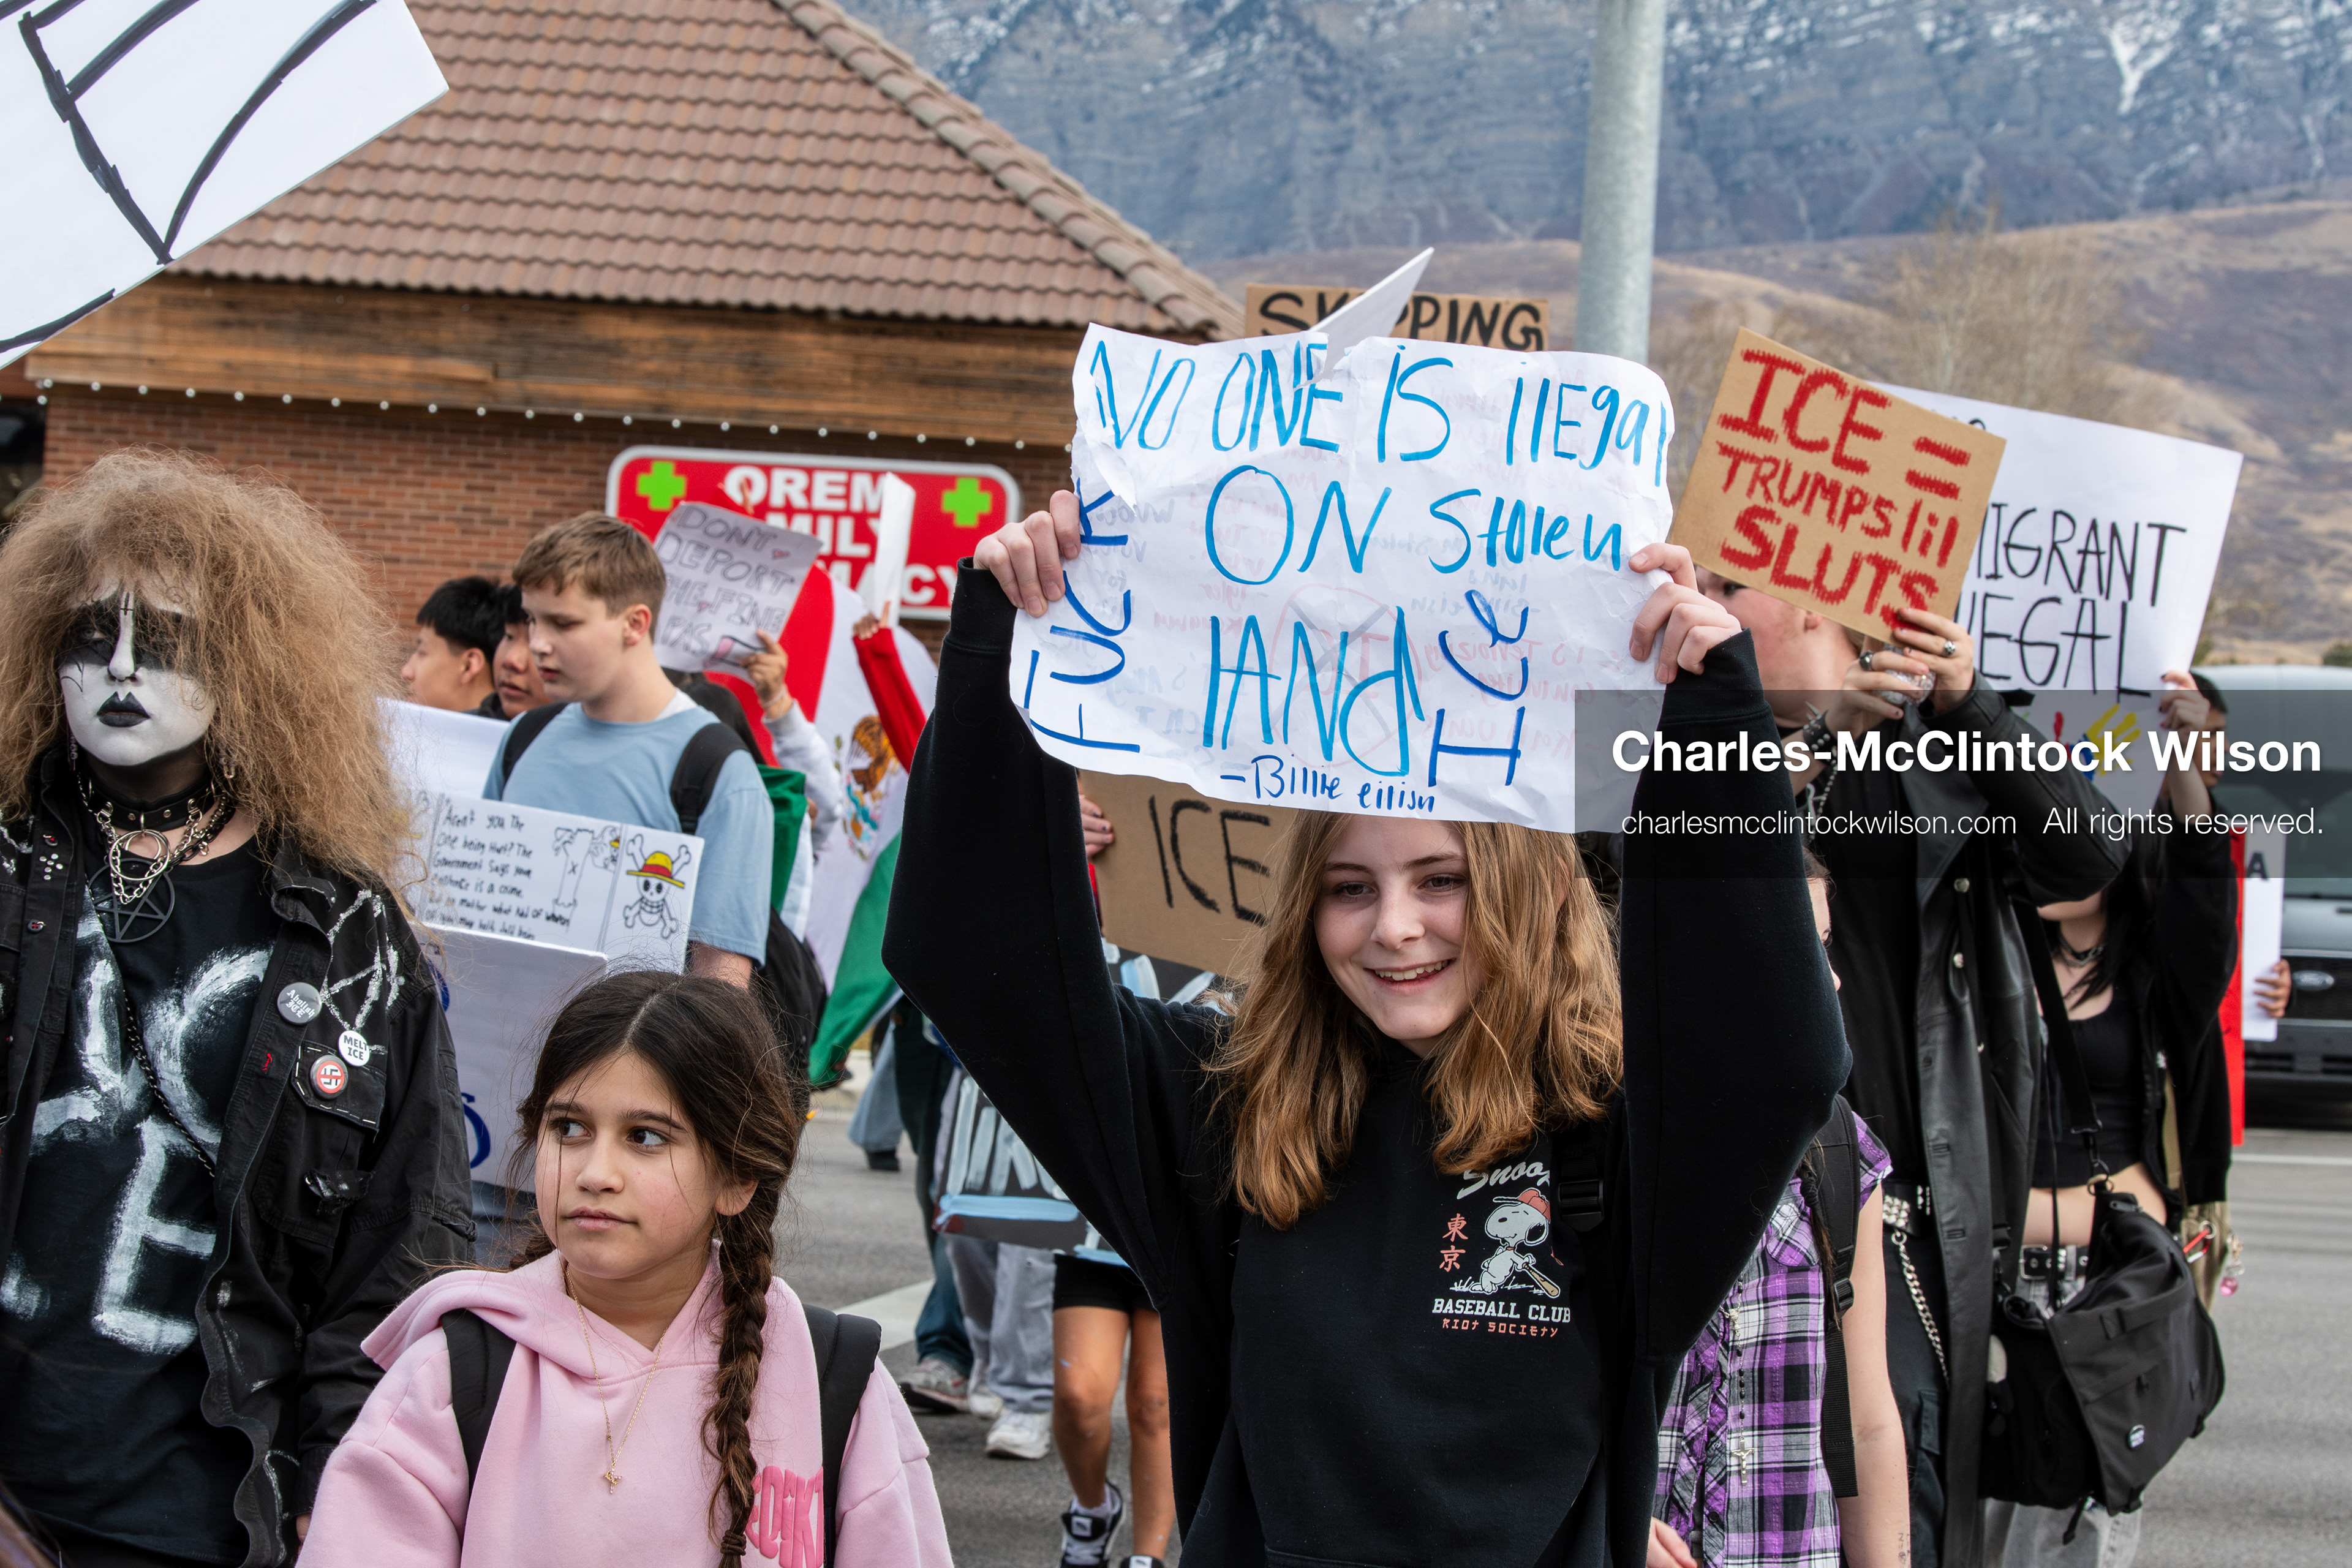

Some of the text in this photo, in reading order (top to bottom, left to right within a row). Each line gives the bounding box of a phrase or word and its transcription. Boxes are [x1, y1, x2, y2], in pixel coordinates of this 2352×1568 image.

[1090, 341, 1195, 450] NO
[1212, 341, 1343, 453] ONE
[1718, 347, 1892, 474] ICE
[724, 466, 884, 513] OREM
[1715, 440, 1894, 538] TRUMPS
[1206, 466, 1621, 584] ON Stolen
[656, 531, 794, 596] DEPORT
[1718, 503, 1939, 632] SLUTS
[1149, 796, 1270, 927] ICE
[286, 989, 315, 1018] Abolish
[344, 1035, 368, 1052] MELT
[347, 1047, 364, 1061] ICE
[1439, 1213, 1469, 1272] 東京
[1432, 1298, 1571, 1323] BASEBALL CLUB
